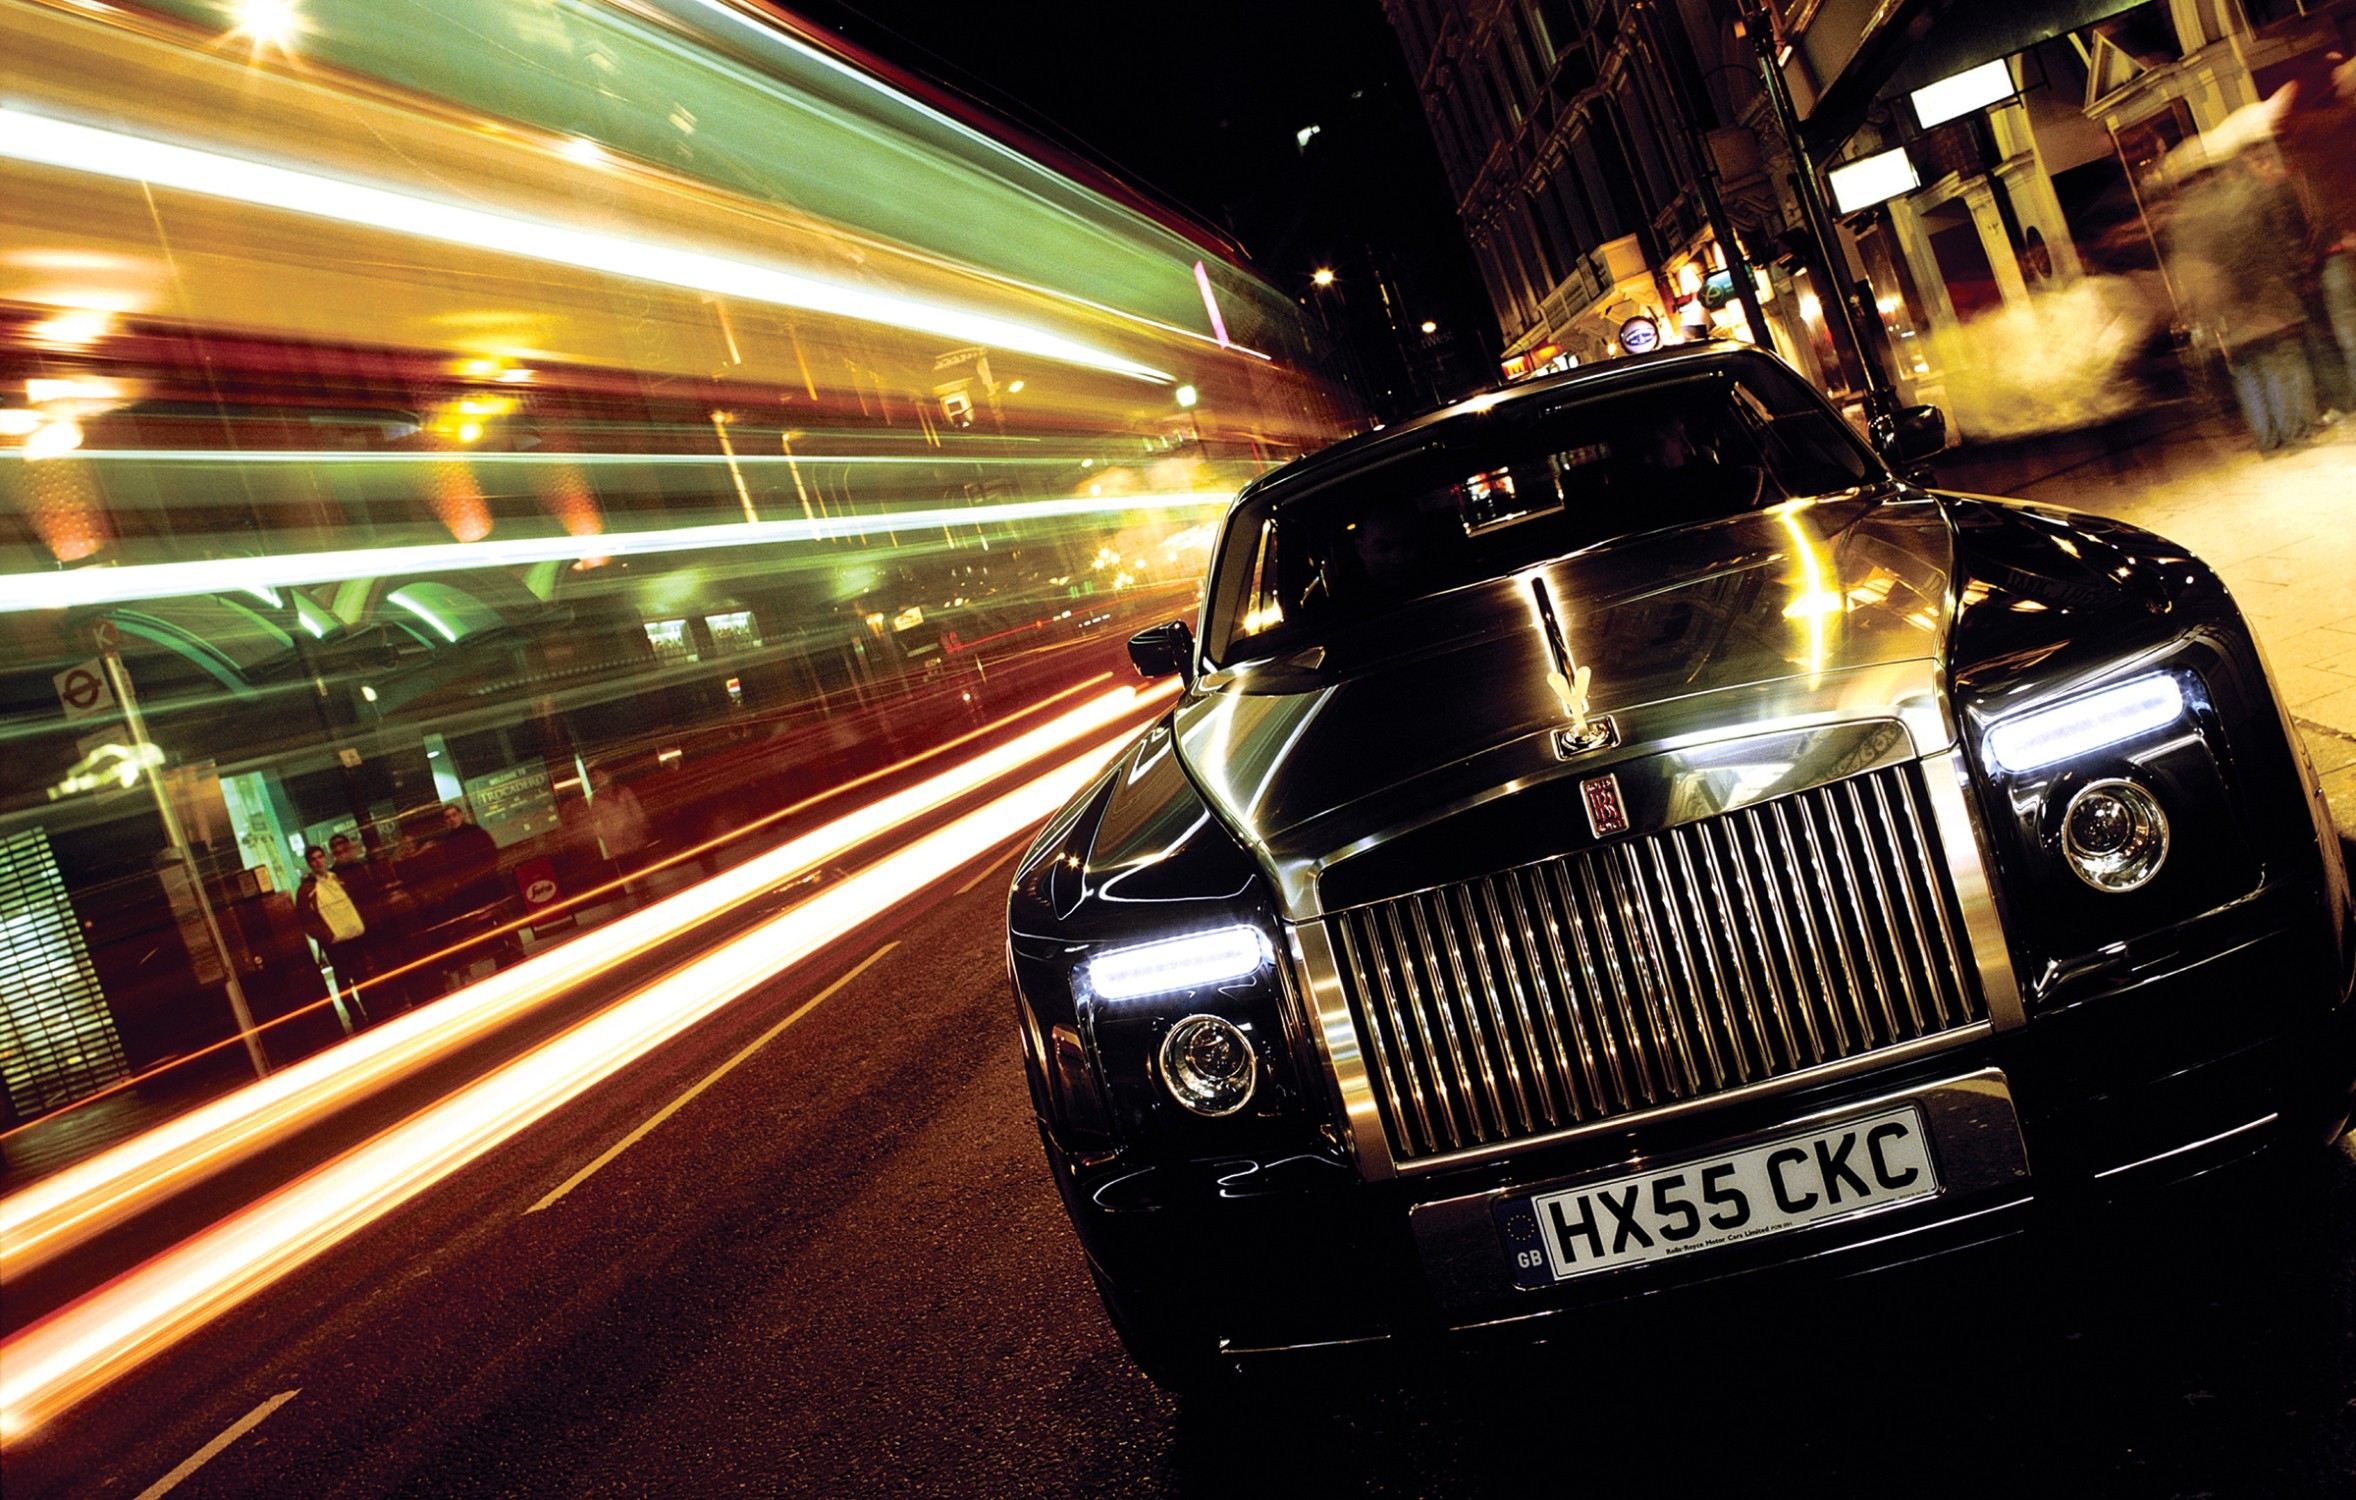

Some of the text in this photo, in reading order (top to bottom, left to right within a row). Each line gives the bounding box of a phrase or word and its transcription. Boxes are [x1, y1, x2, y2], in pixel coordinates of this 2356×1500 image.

[92, 623, 113, 649] K
[481, 774, 545, 803] TROCADERO
[1548, 1121, 1919, 1264] HX55 CKC
[1666, 1242, 1704, 1255] Rolls-Royce
[1705, 1237, 1726, 1247] Motor
[1727, 1233, 1743, 1241] Cars
[1744, 1226, 1770, 1237] Limited
[1517, 1249, 1543, 1269] GB
